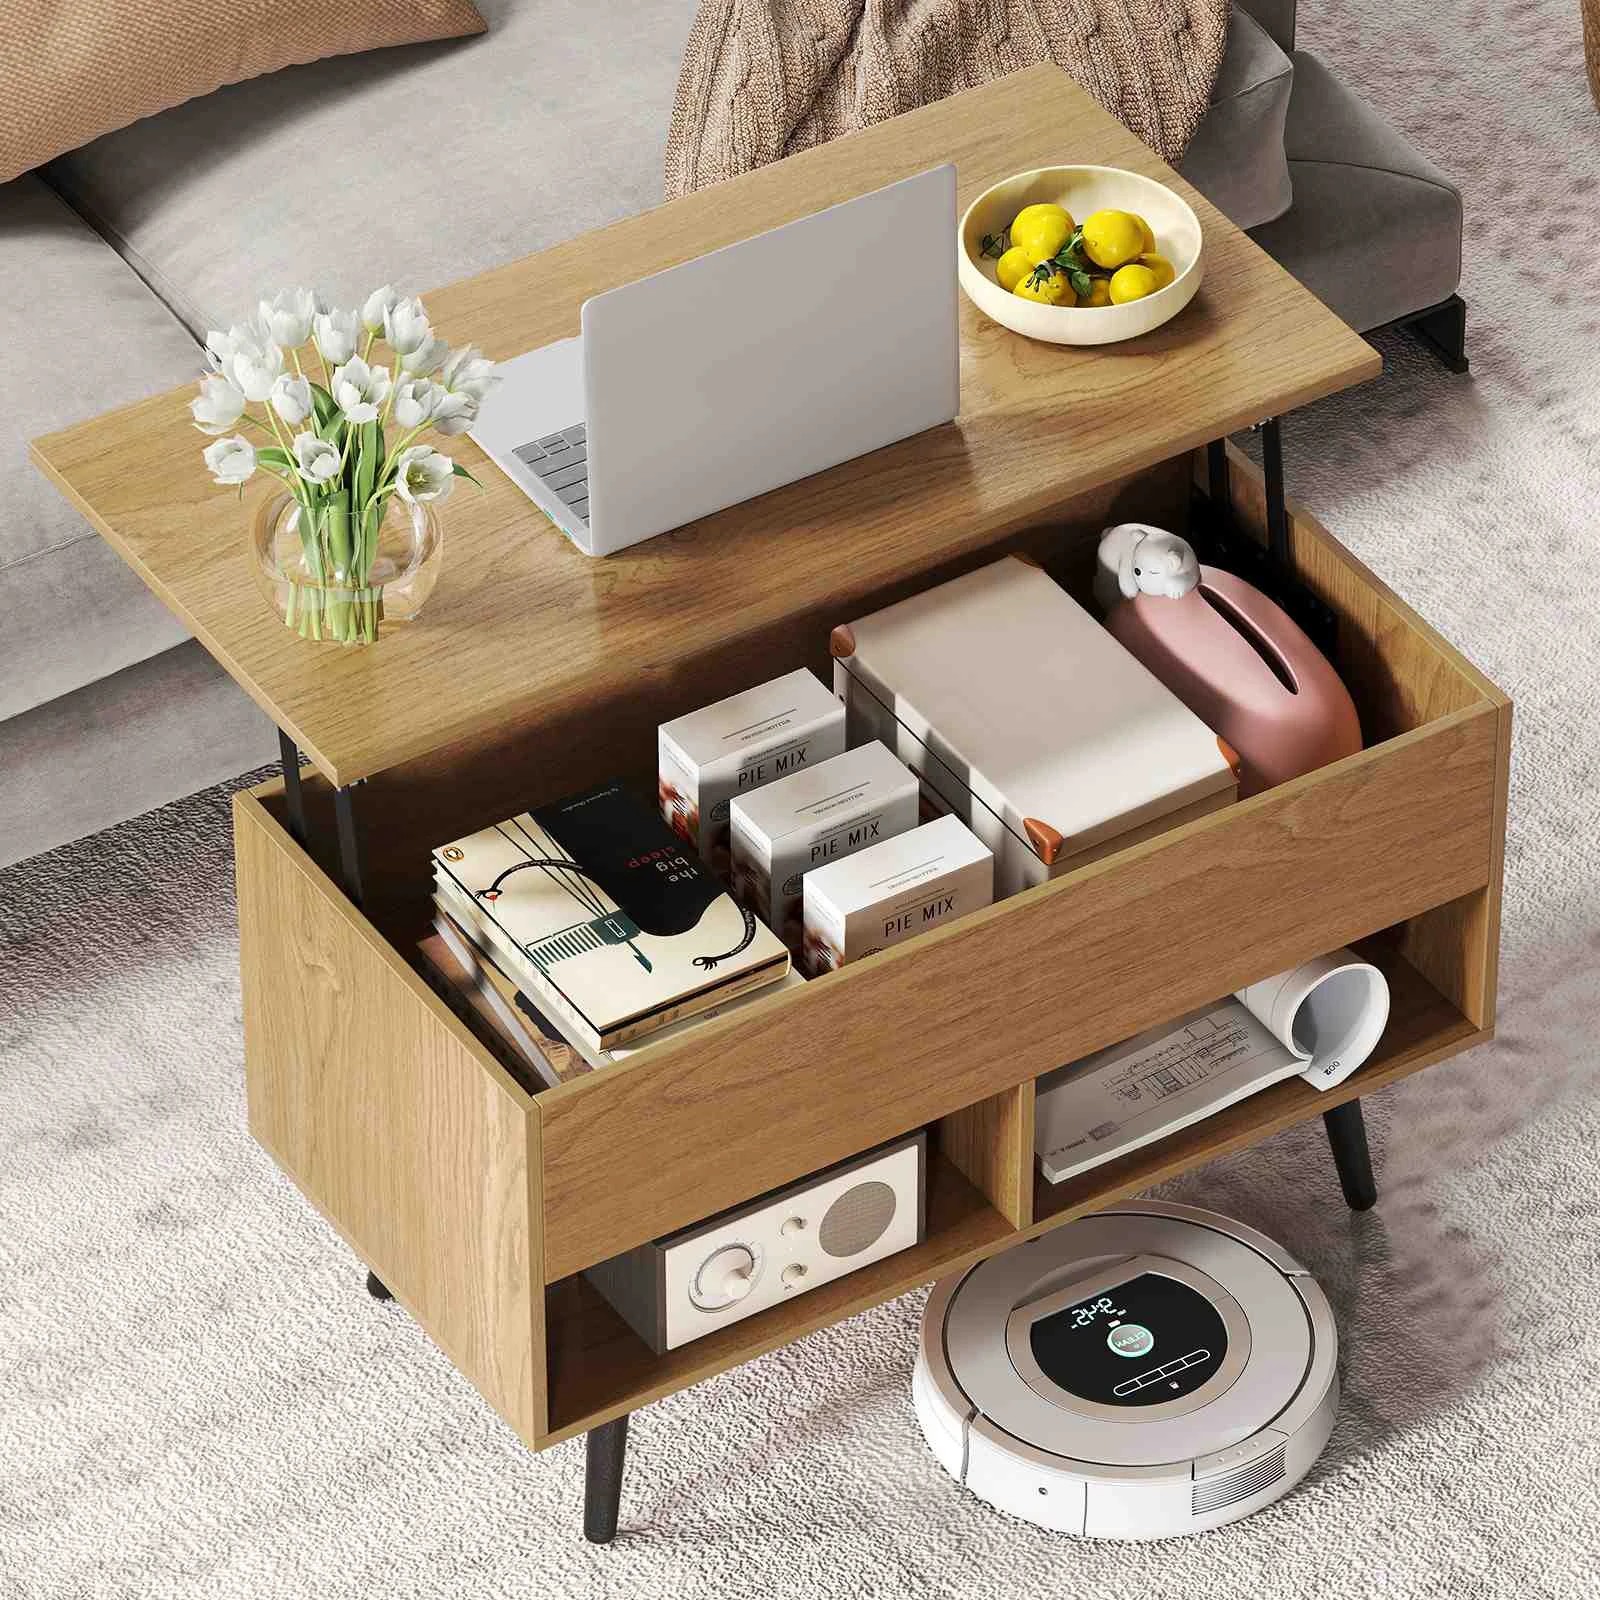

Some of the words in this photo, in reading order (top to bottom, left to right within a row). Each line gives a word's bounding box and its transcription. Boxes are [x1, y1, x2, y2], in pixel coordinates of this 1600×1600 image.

[737, 765, 768, 788] PIE
[775, 747, 809, 774] MIX
[809, 837, 840, 863] PIE
[848, 821, 881, 847] MIX
[655, 856, 689, 872] big
[668, 867, 699, 882] the
[883, 912, 913, 937] PIE
[922, 896, 955, 922] MIX
